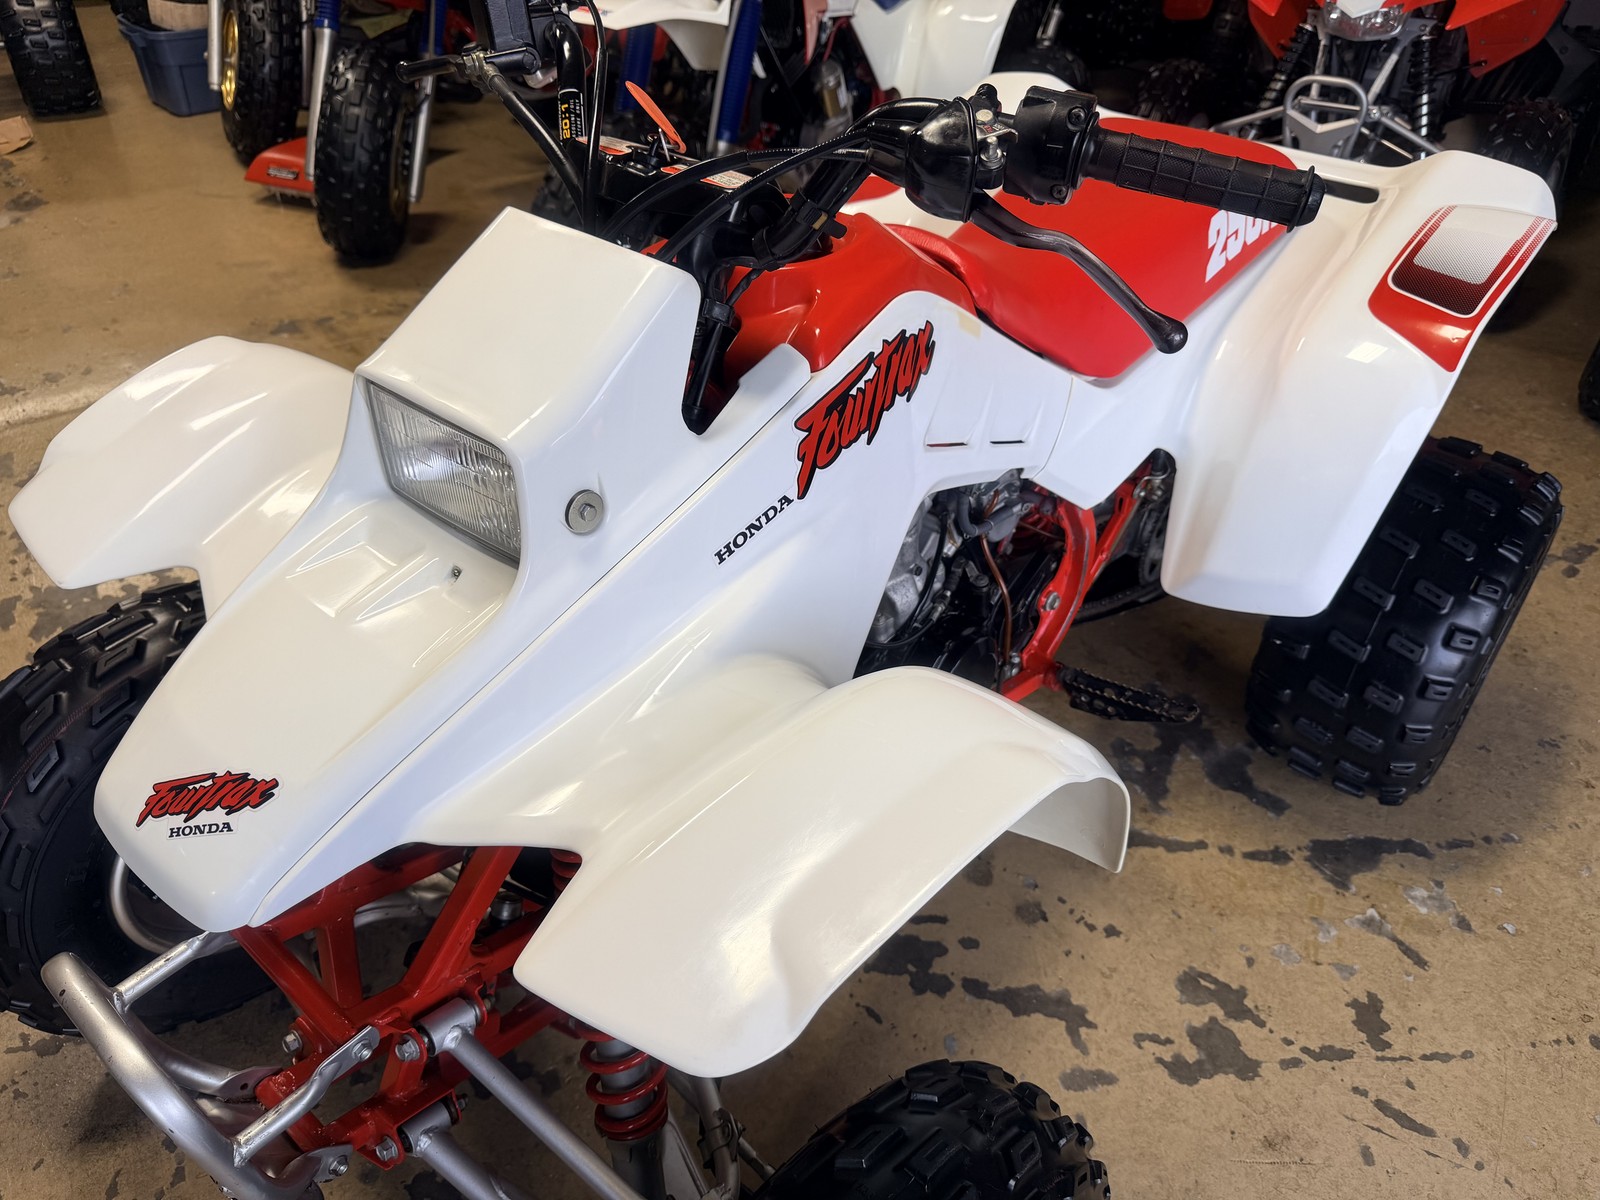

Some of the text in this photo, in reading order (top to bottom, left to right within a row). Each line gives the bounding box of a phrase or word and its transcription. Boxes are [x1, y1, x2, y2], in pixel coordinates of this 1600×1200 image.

[561, 103, 571, 139] 20:1
[1204, 209, 1279, 283] 25
[713, 494, 795, 566] HONDA
[168, 822, 233, 838] HONDA
